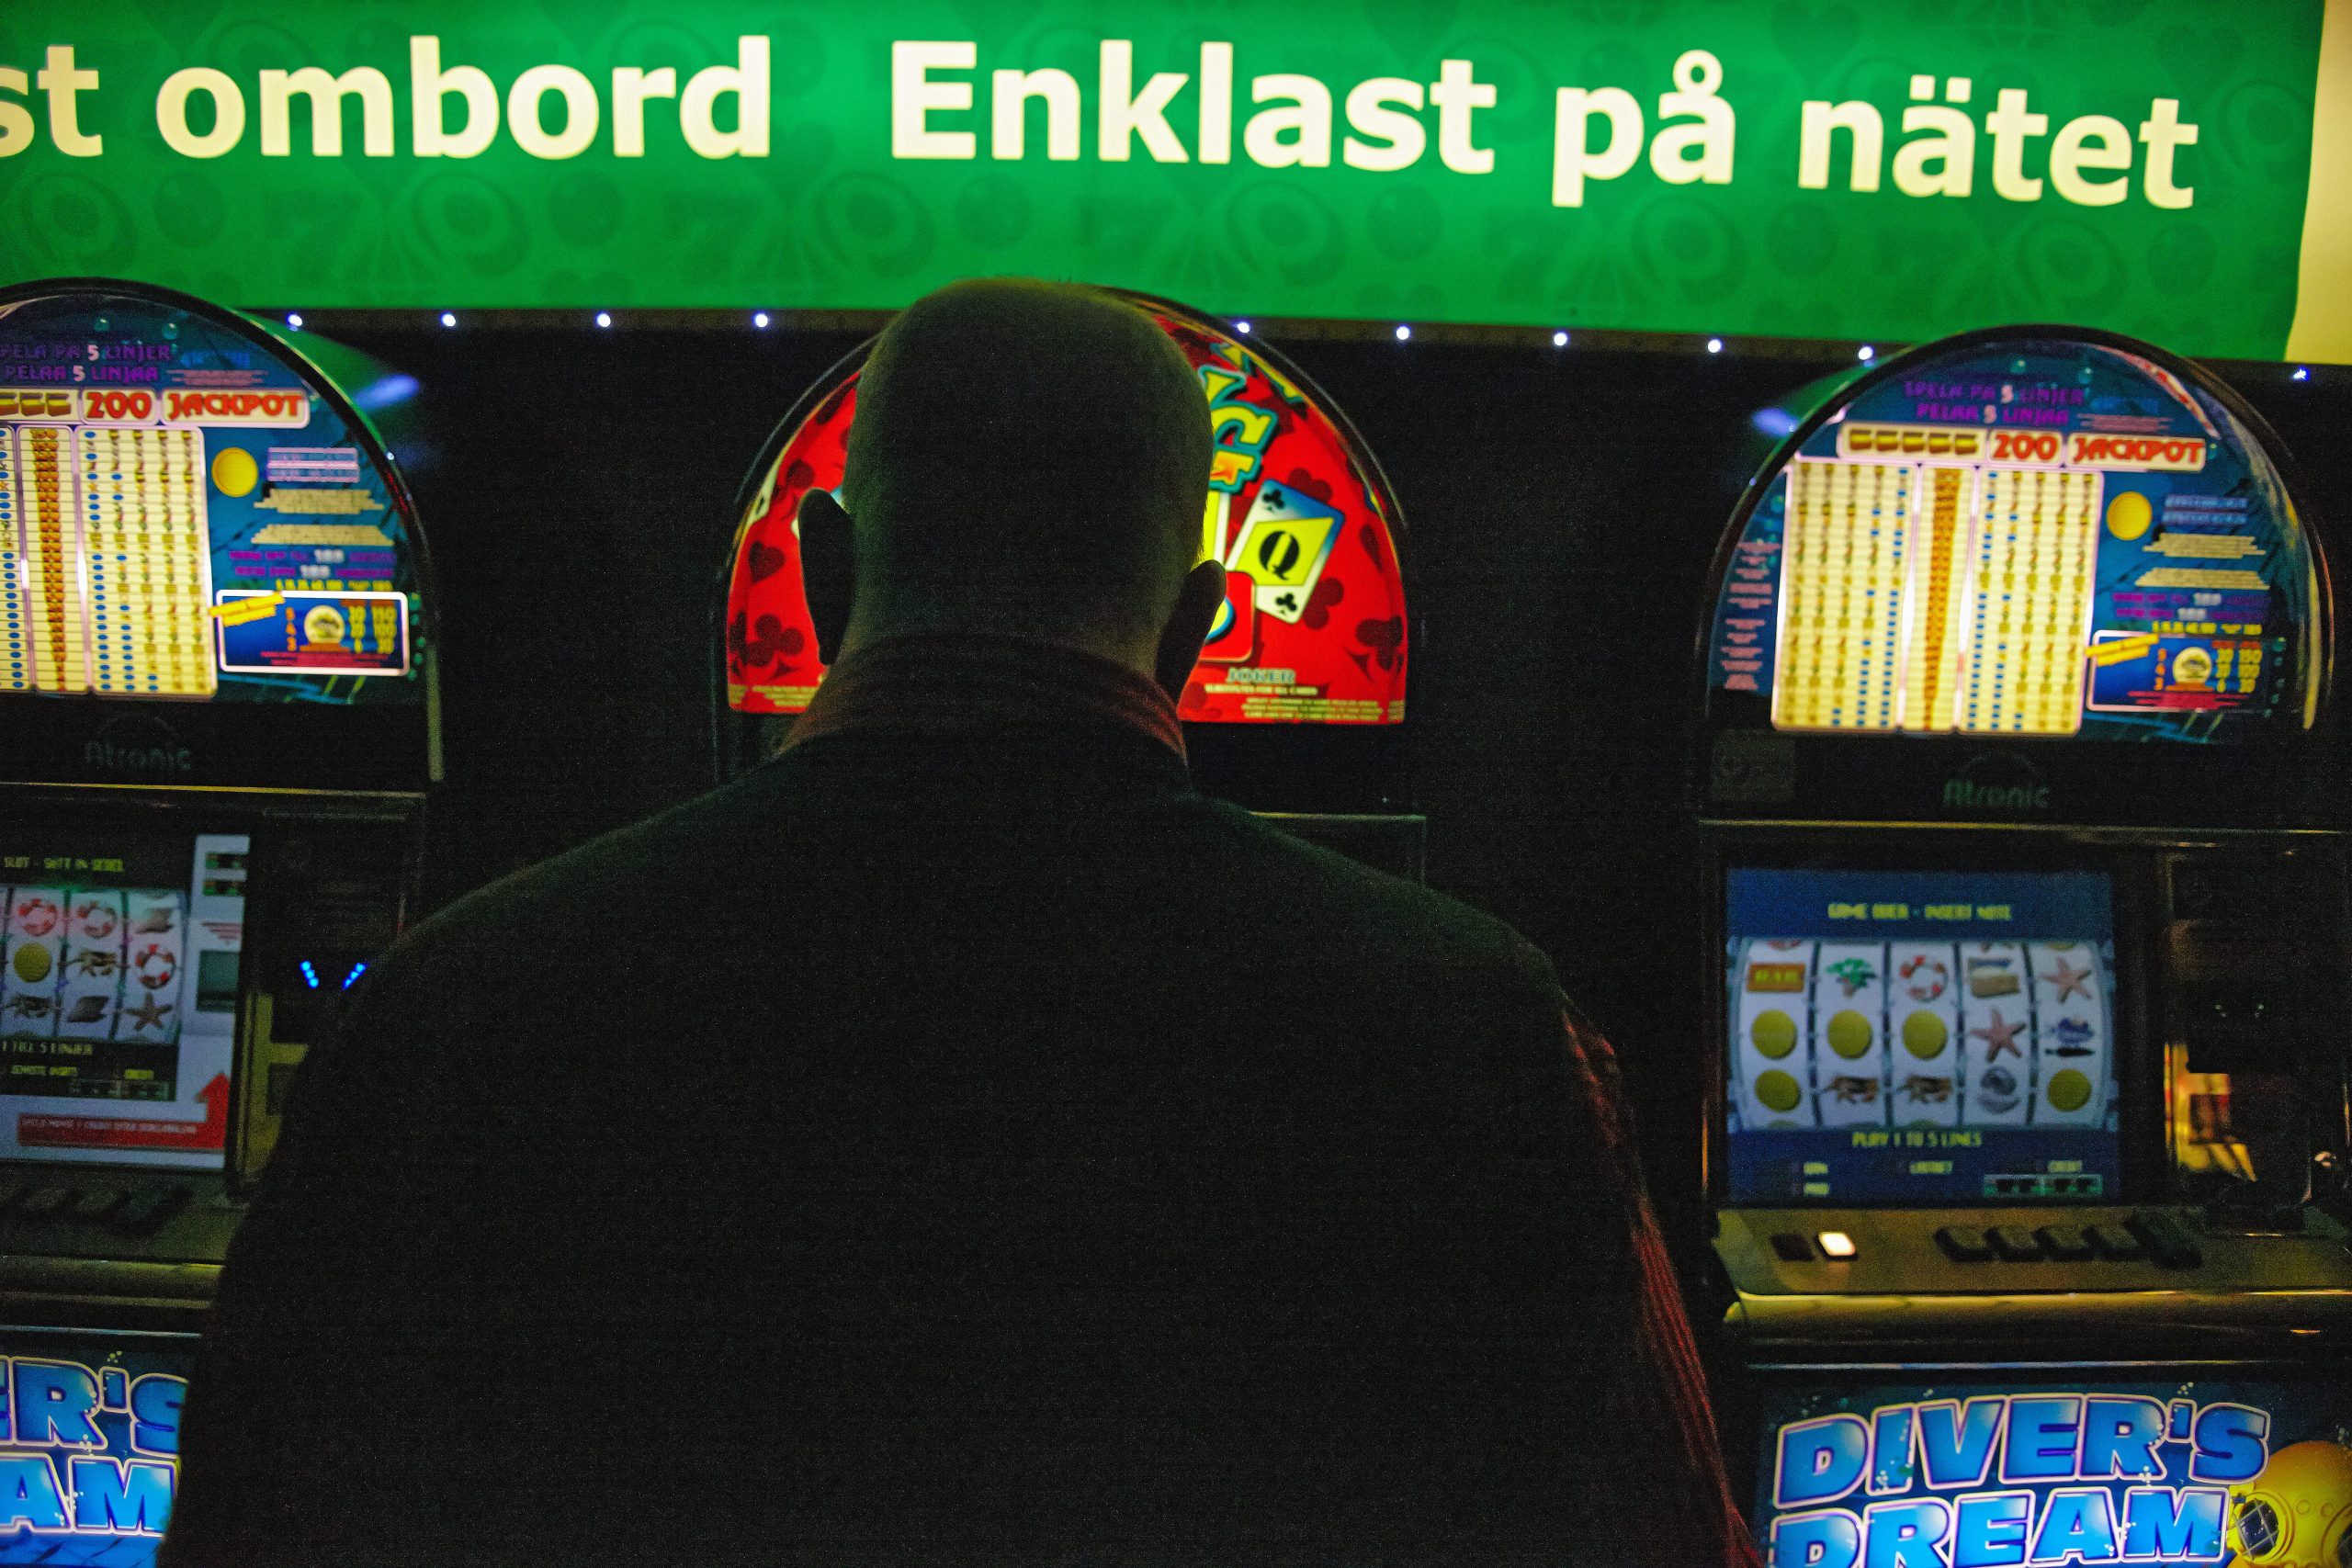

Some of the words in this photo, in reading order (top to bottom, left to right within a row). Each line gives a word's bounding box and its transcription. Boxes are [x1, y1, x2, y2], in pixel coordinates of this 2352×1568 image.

[155, 35, 770, 159] ombord
[891, 39, 1497, 174] Enklast
[1552, 50, 1736, 208] på
[1798, 74, 2199, 209] nätet
[87, 344, 99, 361] 5
[106, 345, 170, 363] LINJER
[73, 365, 85, 382] 5
[93, 366, 159, 384] LINJAA
[86, 392, 153, 419] 200
[167, 394, 303, 421] JACKPOT
[2001, 384, 2014, 404] 5
[1984, 404, 1996, 424] 5
[1994, 434, 2058, 460] 200
[2074, 436, 2205, 464] JACKPOT
[1259, 529, 1300, 581] Q
[1226, 667, 1296, 685] JOKER
[85, 740, 192, 771] Atronic
[1941, 778, 2051, 809] Atronic
[1852, 1132, 1888, 1147] PLAY
[0, 1354, 189, 1461] R'S
[1773, 1393, 2271, 1507] DIVER'S
[1769, 1485, 2231, 1568] DREAM
